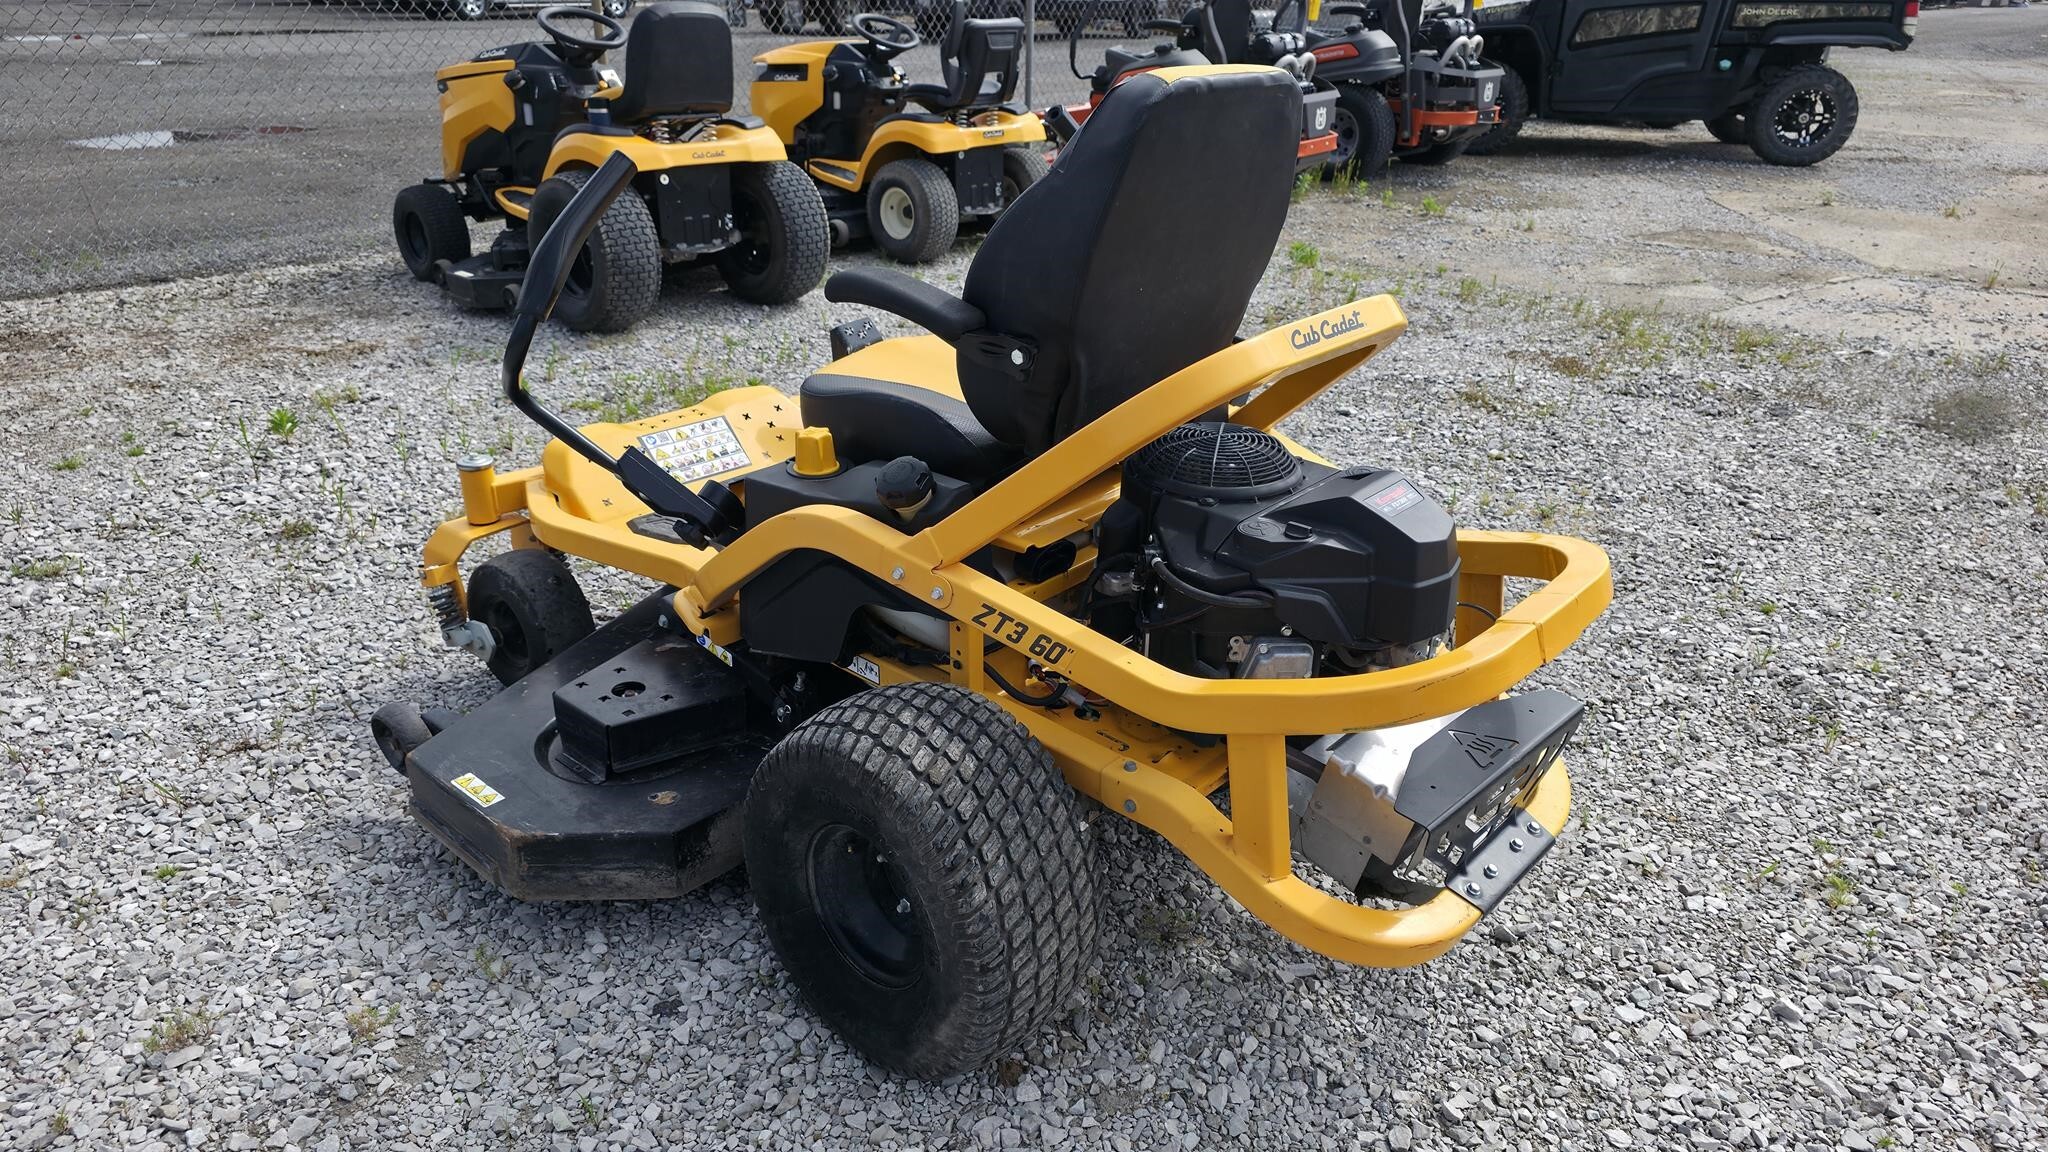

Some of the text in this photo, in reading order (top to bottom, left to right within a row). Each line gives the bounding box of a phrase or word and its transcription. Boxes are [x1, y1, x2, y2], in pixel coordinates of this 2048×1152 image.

[1740, 7, 1800, 16] JOHN DEERE
[1291, 310, 1364, 349] Cub Cadet
[971, 603, 1074, 665] ZT3 60"
